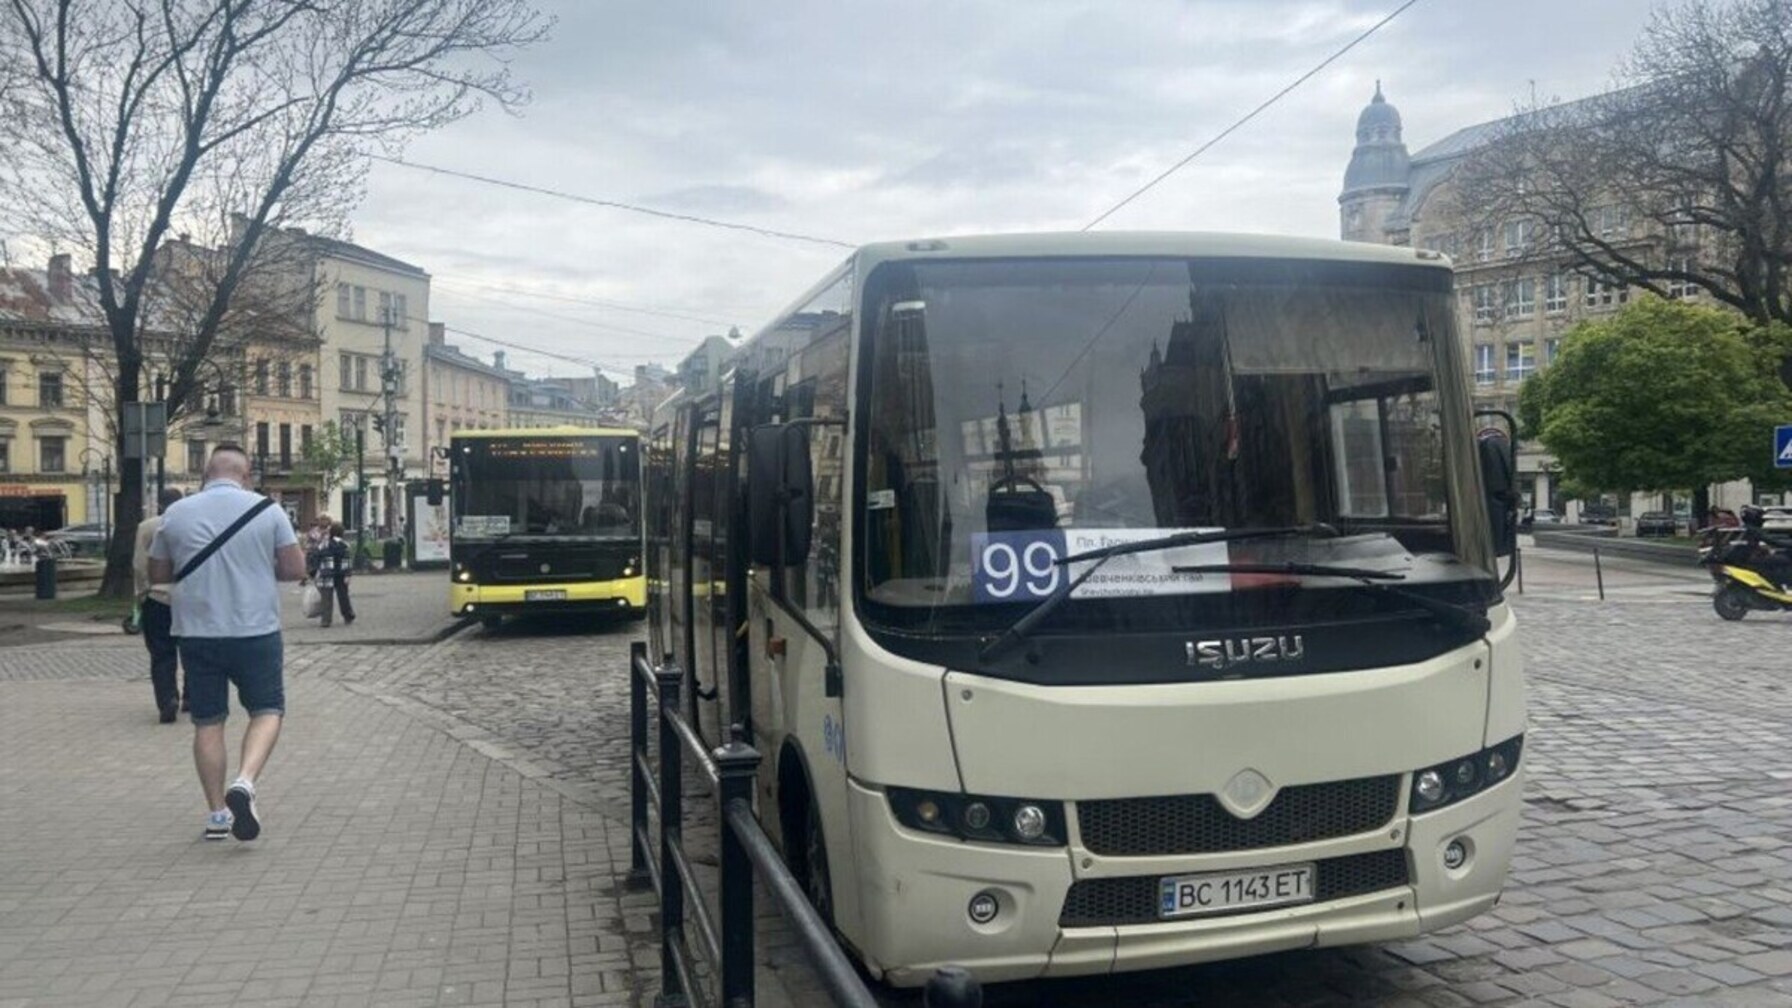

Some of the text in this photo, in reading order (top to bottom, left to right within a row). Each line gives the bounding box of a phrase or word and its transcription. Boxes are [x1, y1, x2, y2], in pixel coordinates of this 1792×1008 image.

[983, 541, 1059, 597] 99
[1185, 635, 1304, 666] ISUZU
[1179, 882, 1213, 908] BC
[1220, 875, 1270, 904] 1143
[1276, 870, 1307, 897] ET
